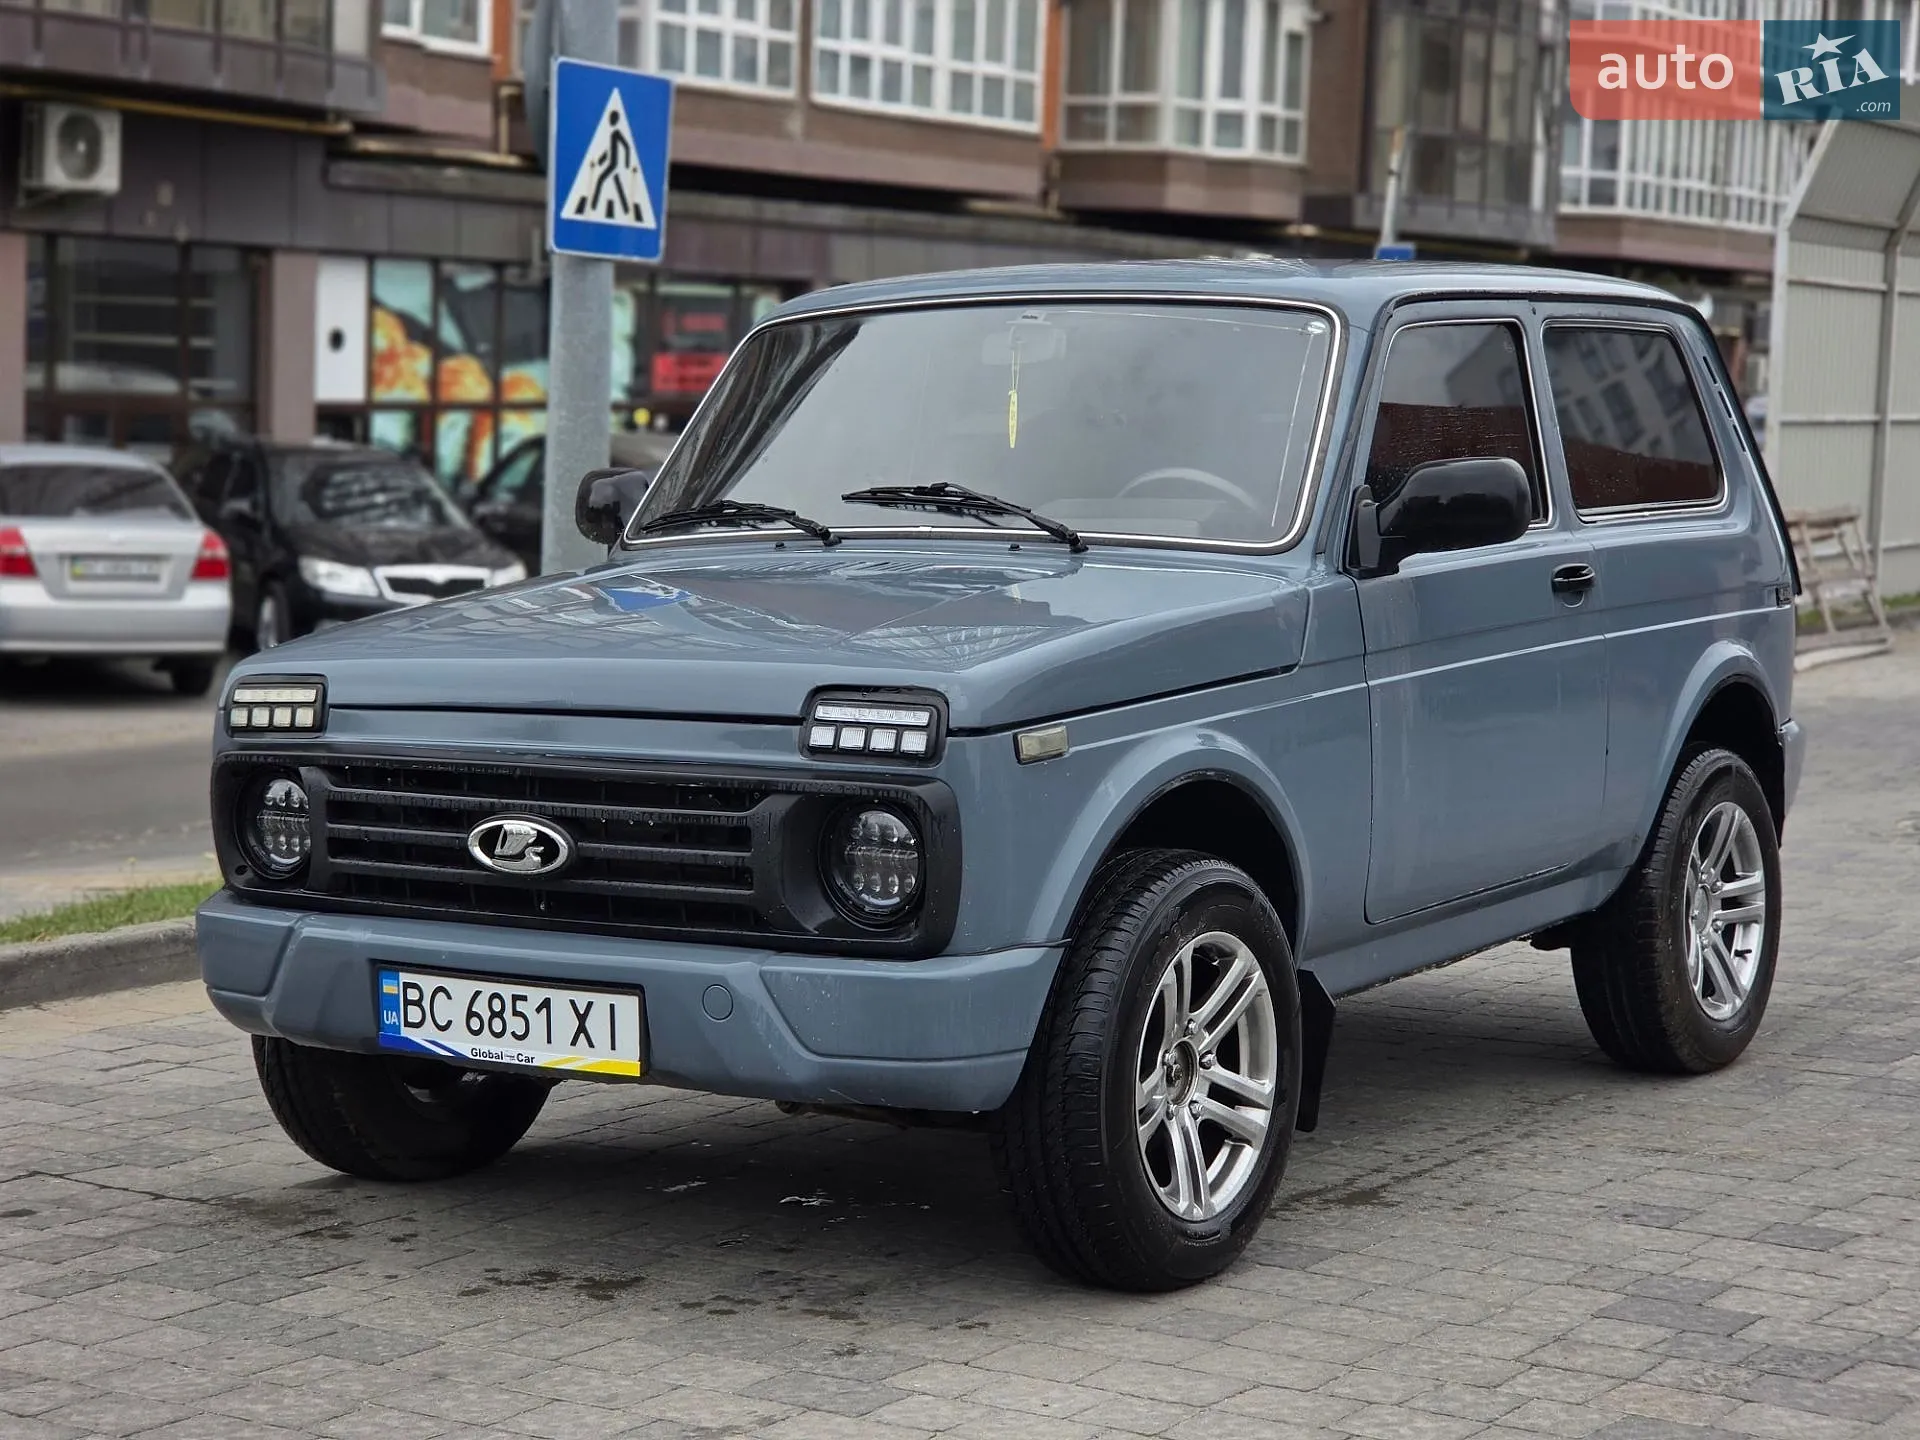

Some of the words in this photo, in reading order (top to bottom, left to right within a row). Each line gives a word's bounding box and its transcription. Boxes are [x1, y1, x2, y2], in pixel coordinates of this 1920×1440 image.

[383, 1009, 399, 1026] UA
[402, 981, 453, 1032] BC
[465, 989, 553, 1045] 6851
[470, 1047, 504, 1061] Global
[516, 1052, 536, 1064] Car
